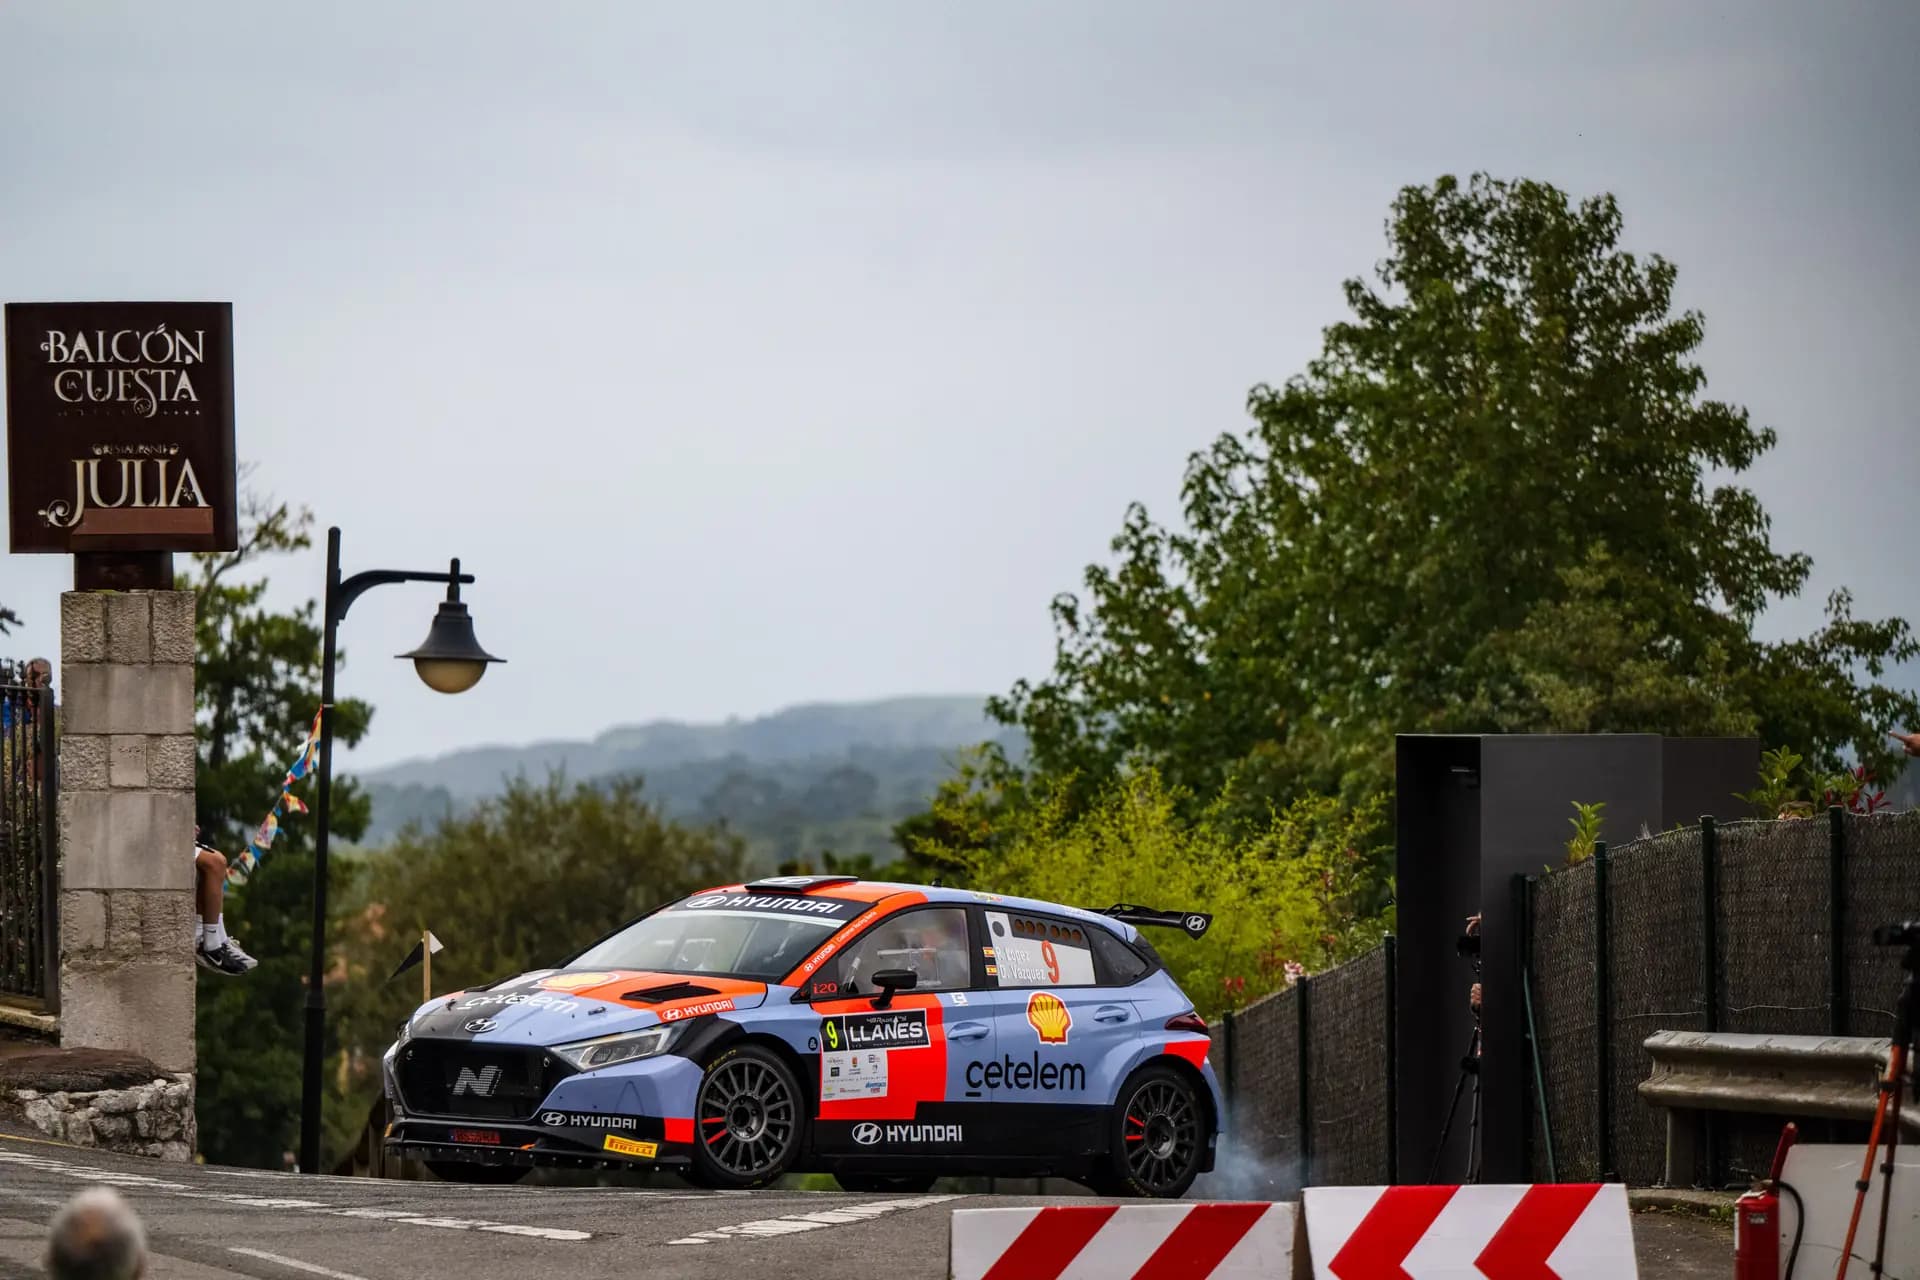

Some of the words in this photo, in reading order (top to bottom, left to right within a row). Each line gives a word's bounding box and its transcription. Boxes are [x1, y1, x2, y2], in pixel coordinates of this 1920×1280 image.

[41, 323, 206, 363] BALCÓN
[54, 368, 200, 418] CUESTA
[38, 458, 211, 528] JULIA
[724, 896, 843, 914] HYUNDAI
[1041, 940, 1060, 984] 9
[813, 982, 838, 994] i20
[683, 1000, 733, 1016] HYUNDAI
[826, 1021, 838, 1048] 9
[849, 1017, 923, 1042] LLANES
[966, 1051, 1086, 1092] cetelem
[570, 1115, 637, 1130] HYUNDAI
[886, 1125, 962, 1142] HYUNDAI
